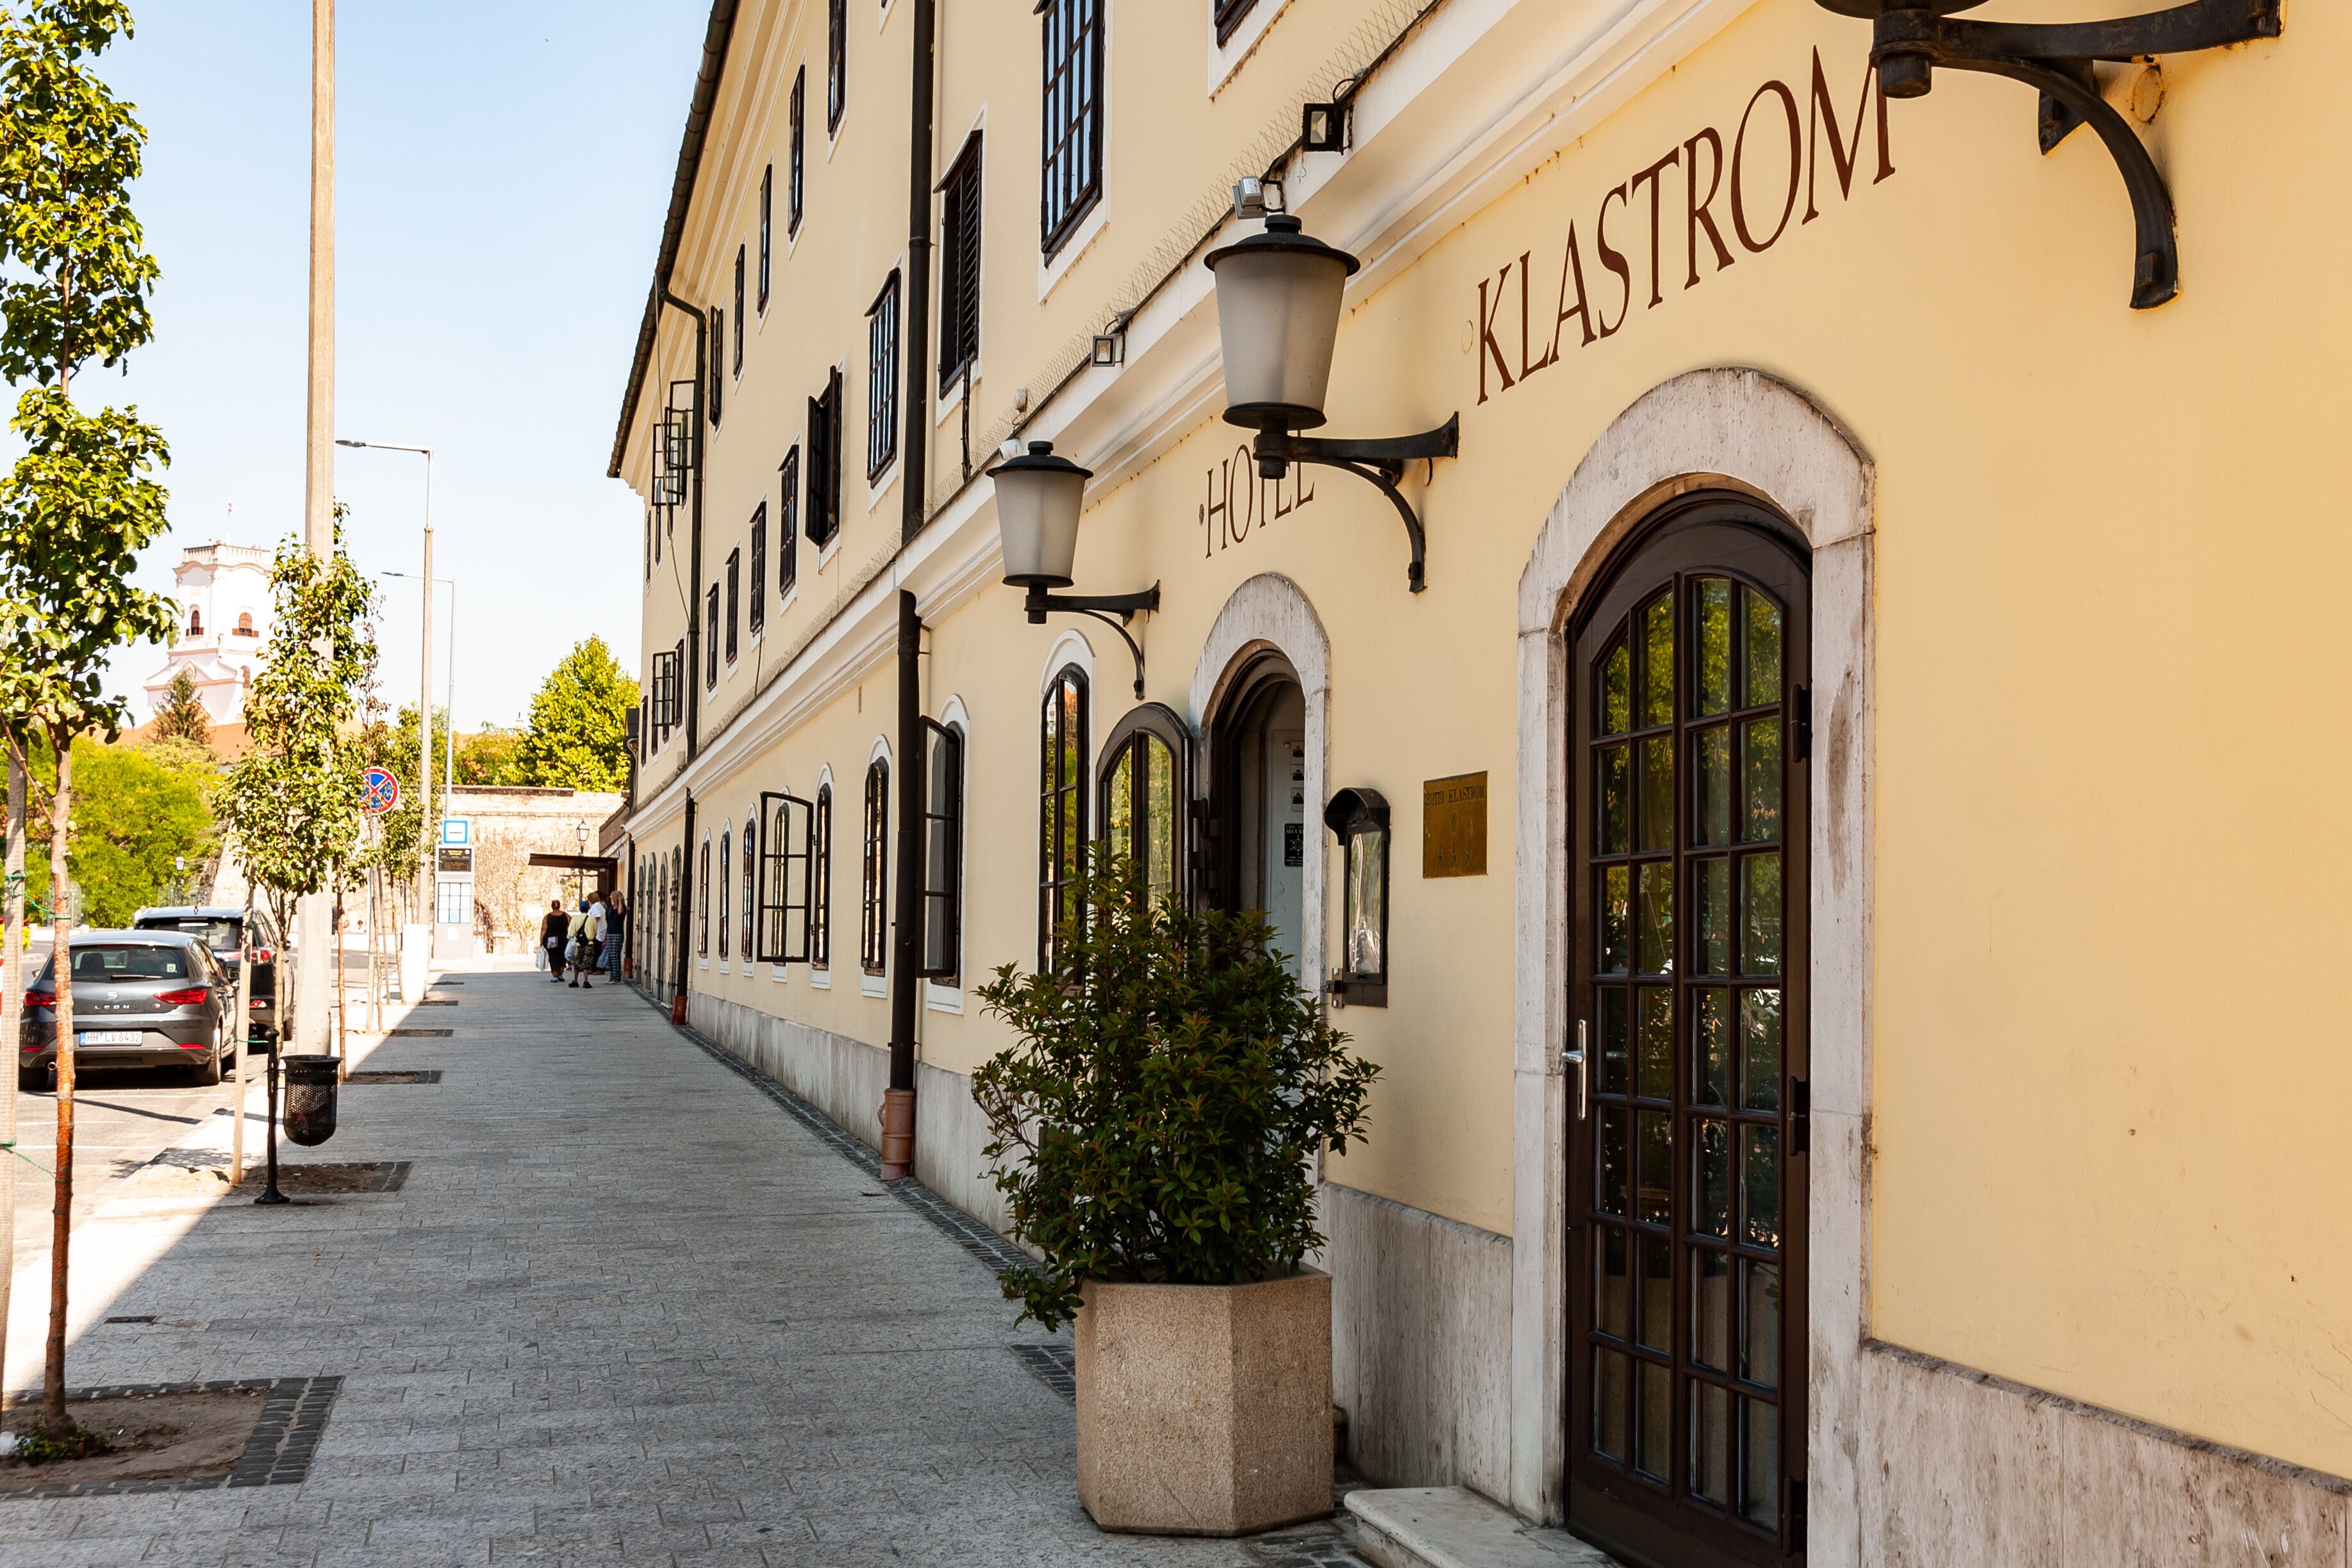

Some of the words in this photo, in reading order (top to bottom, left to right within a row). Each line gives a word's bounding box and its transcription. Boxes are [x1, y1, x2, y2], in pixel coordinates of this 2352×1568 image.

[1477, 44, 1896, 406] KLASTROM
[1425, 791, 1445, 807] HOTEL
[1448, 784, 1485, 802] KLASTROM
[87, 1032, 98, 1042] HH
